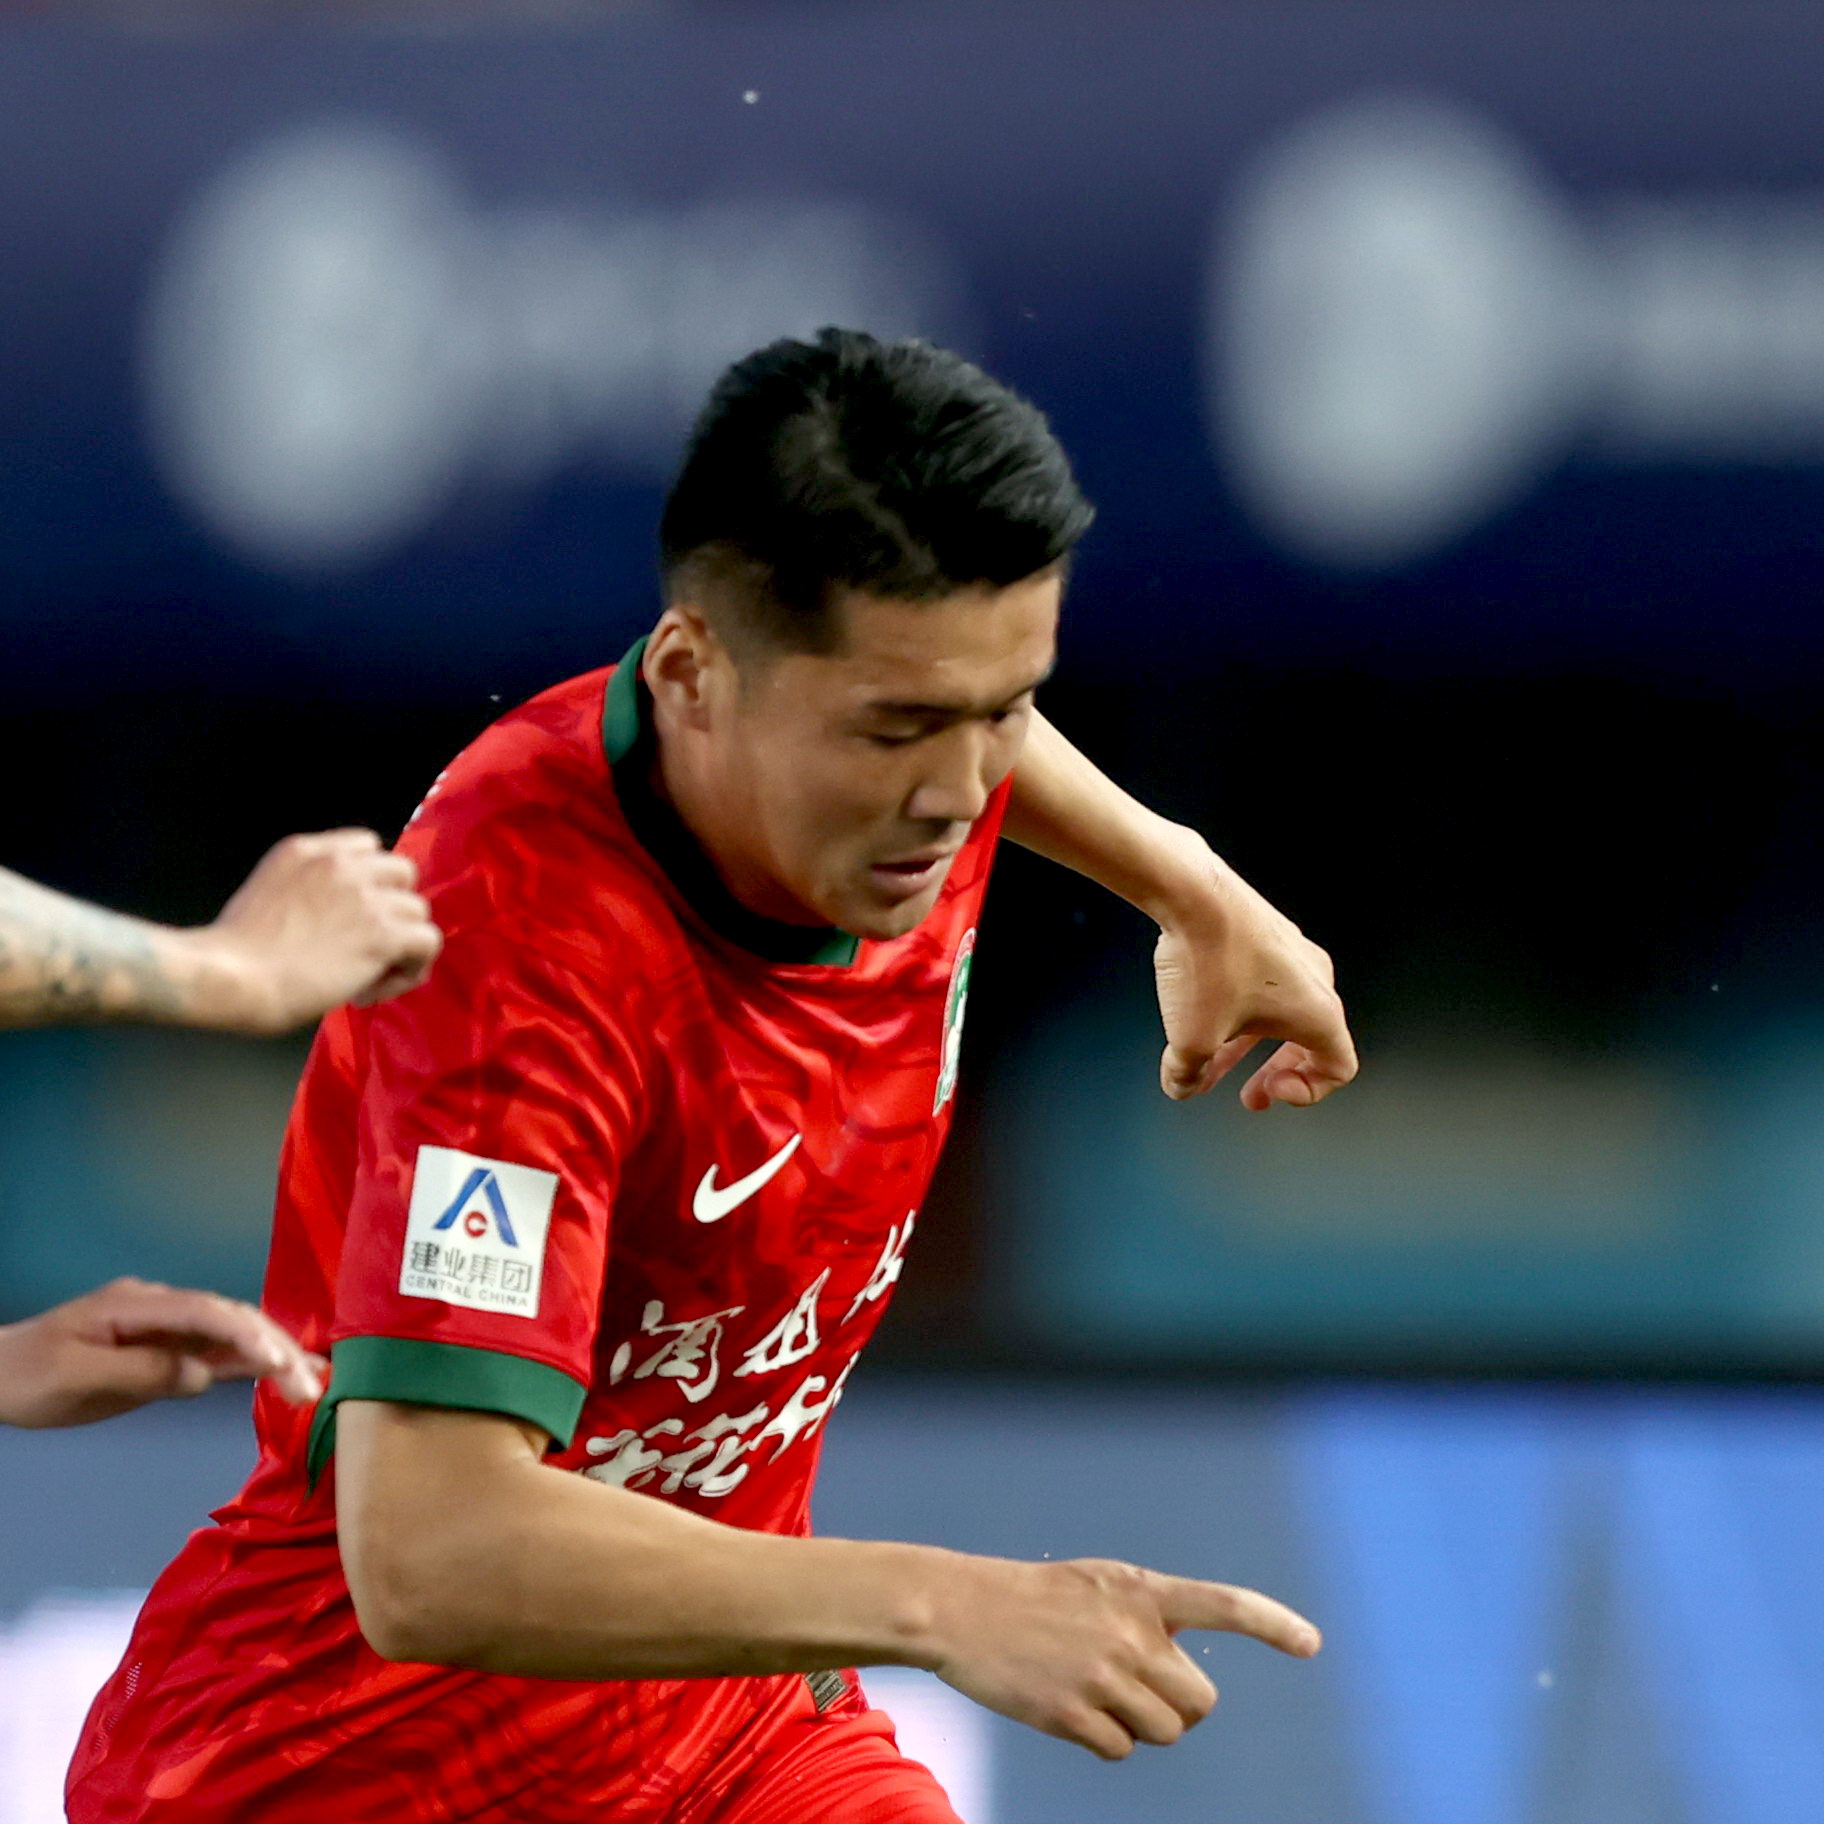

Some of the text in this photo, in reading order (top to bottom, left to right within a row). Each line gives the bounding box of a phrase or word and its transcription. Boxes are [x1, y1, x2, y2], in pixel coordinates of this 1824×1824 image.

[410, 1242, 533, 1294] 建业集团
[405, 1273, 528, 1307] CENTRAL CHINA
